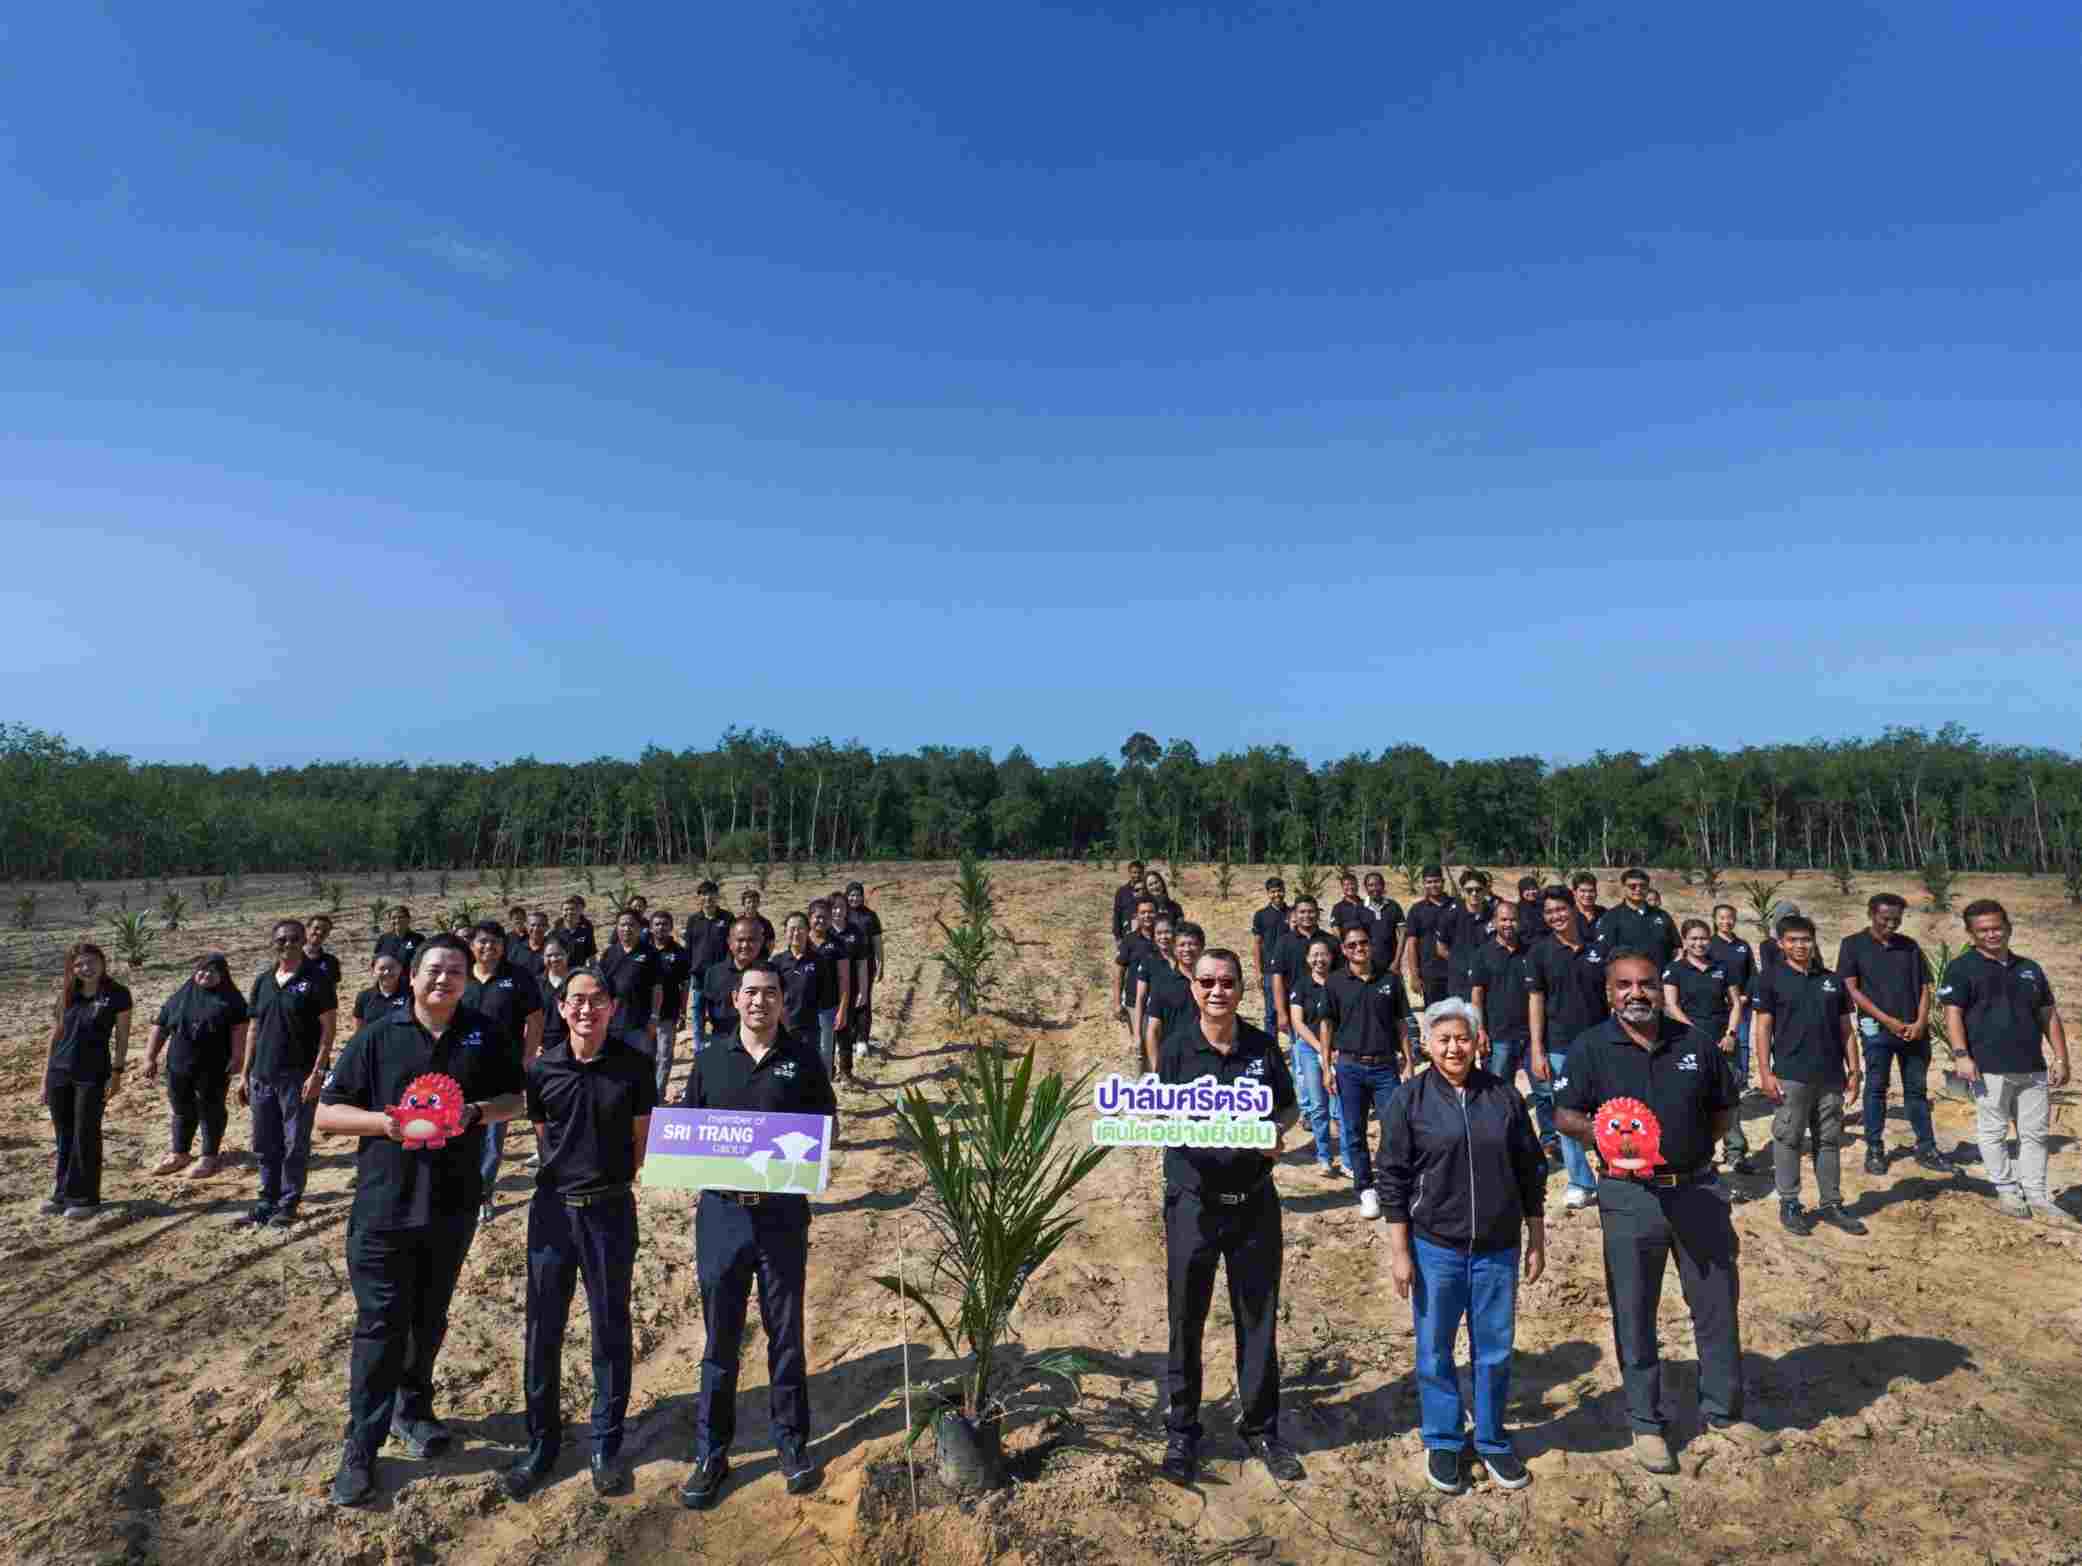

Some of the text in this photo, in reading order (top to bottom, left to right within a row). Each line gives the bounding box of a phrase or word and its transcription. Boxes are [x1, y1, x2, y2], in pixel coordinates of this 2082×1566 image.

[1098, 1077, 1268, 1112] ปาล์มศรีตรัง
[663, 1123, 753, 1143] SRI TRANG
